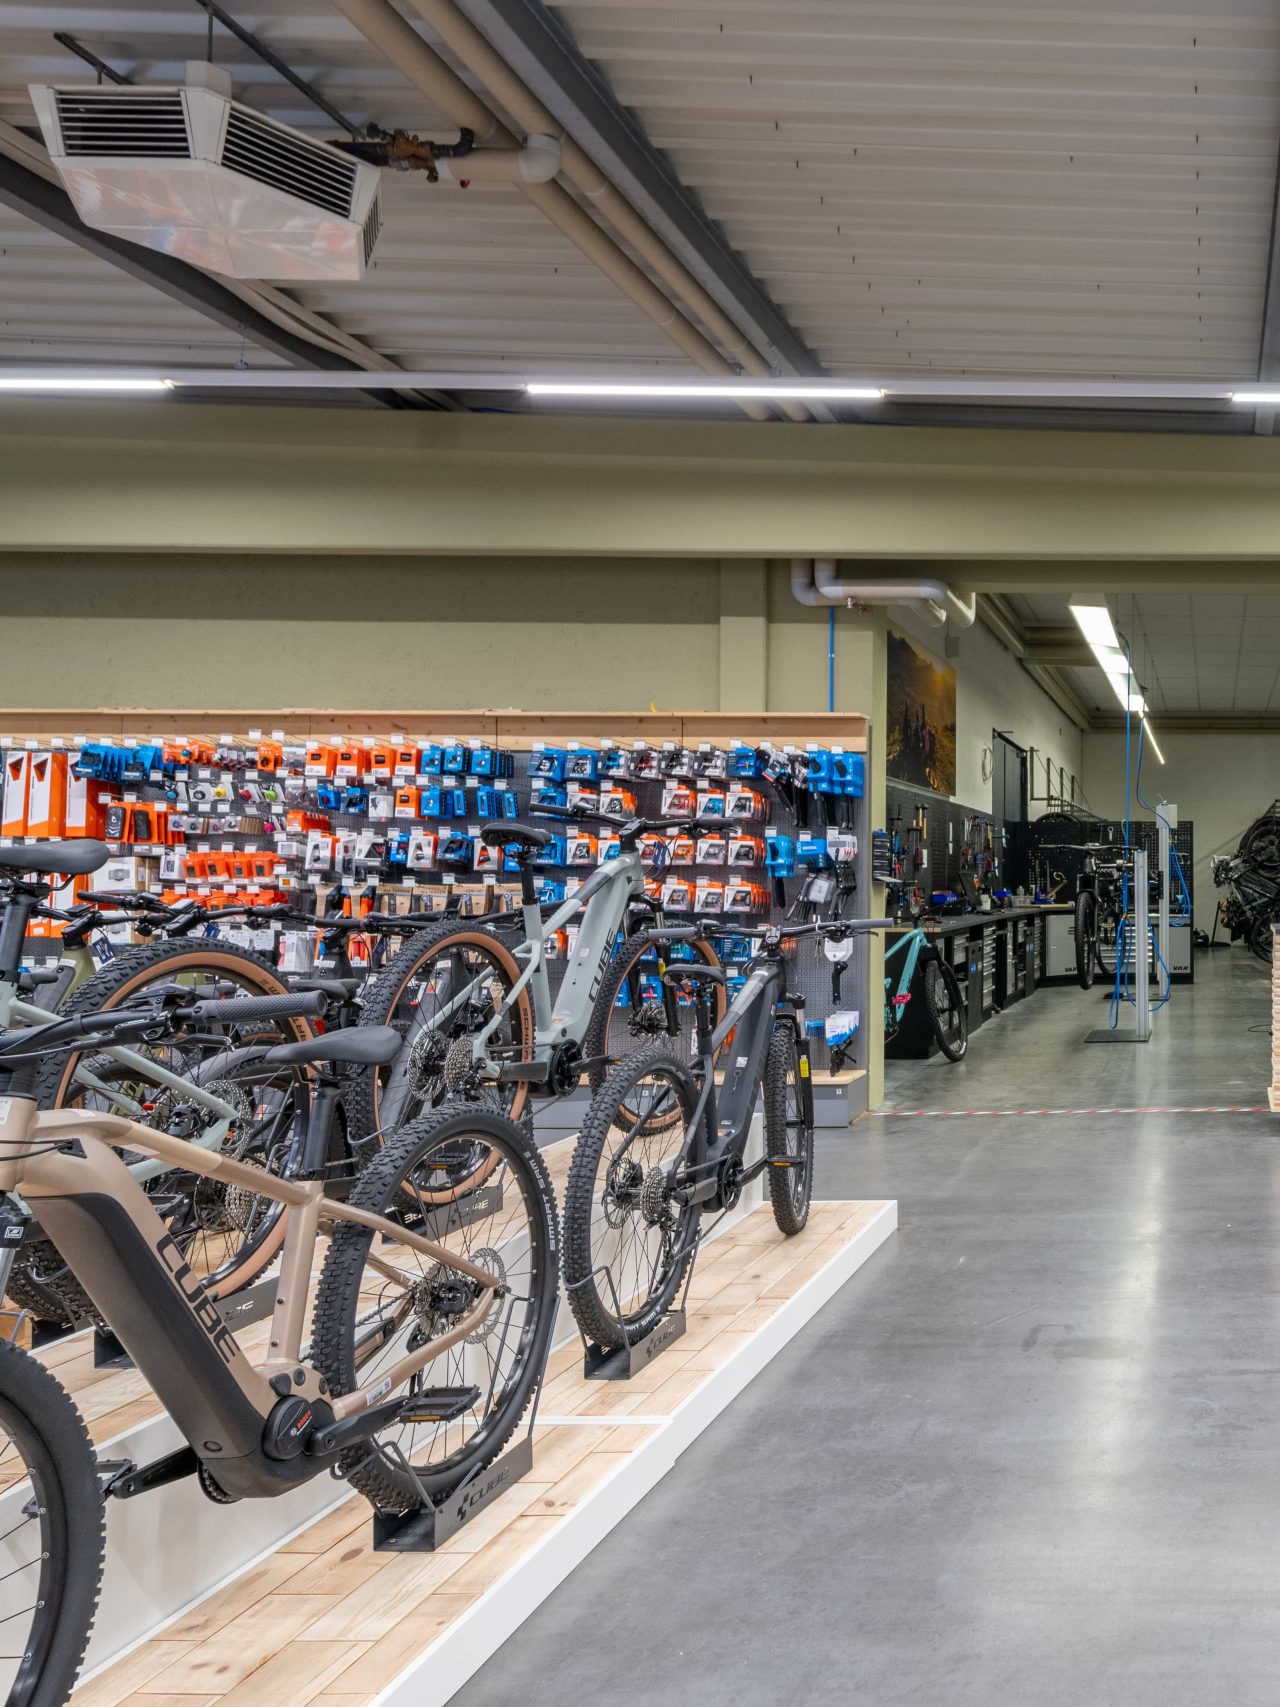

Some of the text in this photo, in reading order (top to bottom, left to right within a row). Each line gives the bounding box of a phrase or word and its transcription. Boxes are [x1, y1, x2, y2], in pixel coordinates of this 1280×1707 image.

[588, 927, 616, 1003] CUBE
[529, 1159, 556, 1250] SMART SAM
[156, 1235, 239, 1363] CUBE
[297, 1410, 312, 1429] BOSCH
[470, 1469, 510, 1508] CUBE
